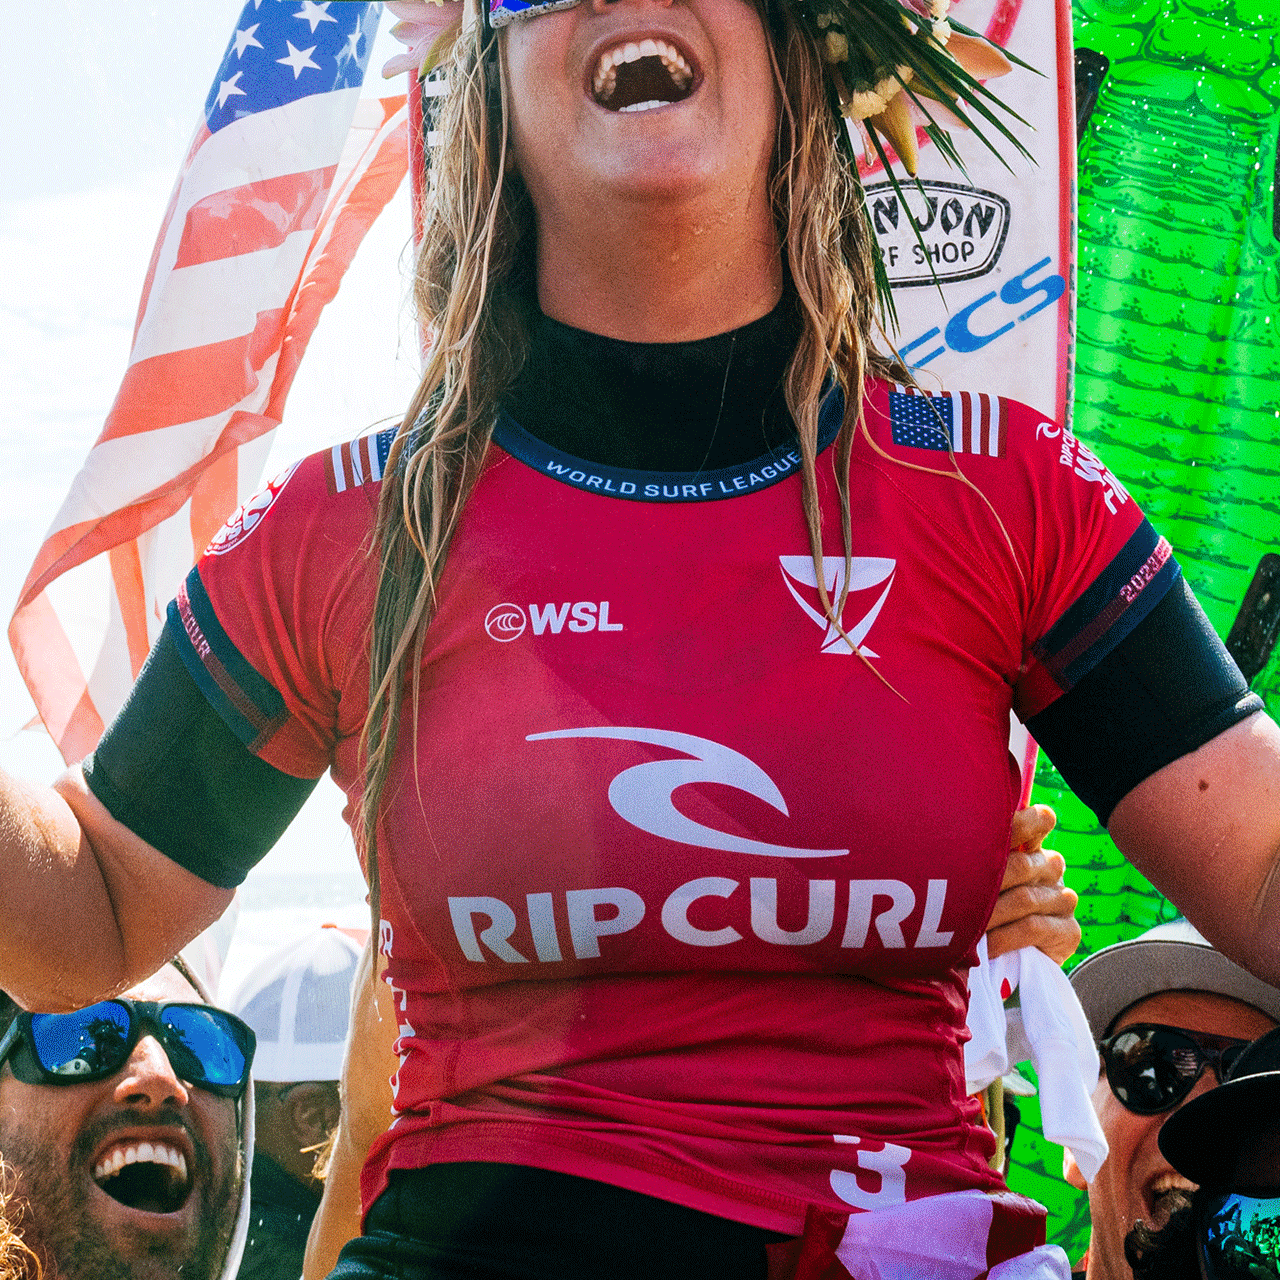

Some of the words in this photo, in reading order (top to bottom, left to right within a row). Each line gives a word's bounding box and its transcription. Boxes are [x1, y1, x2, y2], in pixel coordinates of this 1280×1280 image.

[914, 195, 996, 239] JON
[912, 240, 975, 265] SHOP
[546, 460, 637, 496] WORLD
[644, 483, 714, 498] SURF
[719, 451, 803, 494] LEAGUE
[528, 601, 624, 635] WSL
